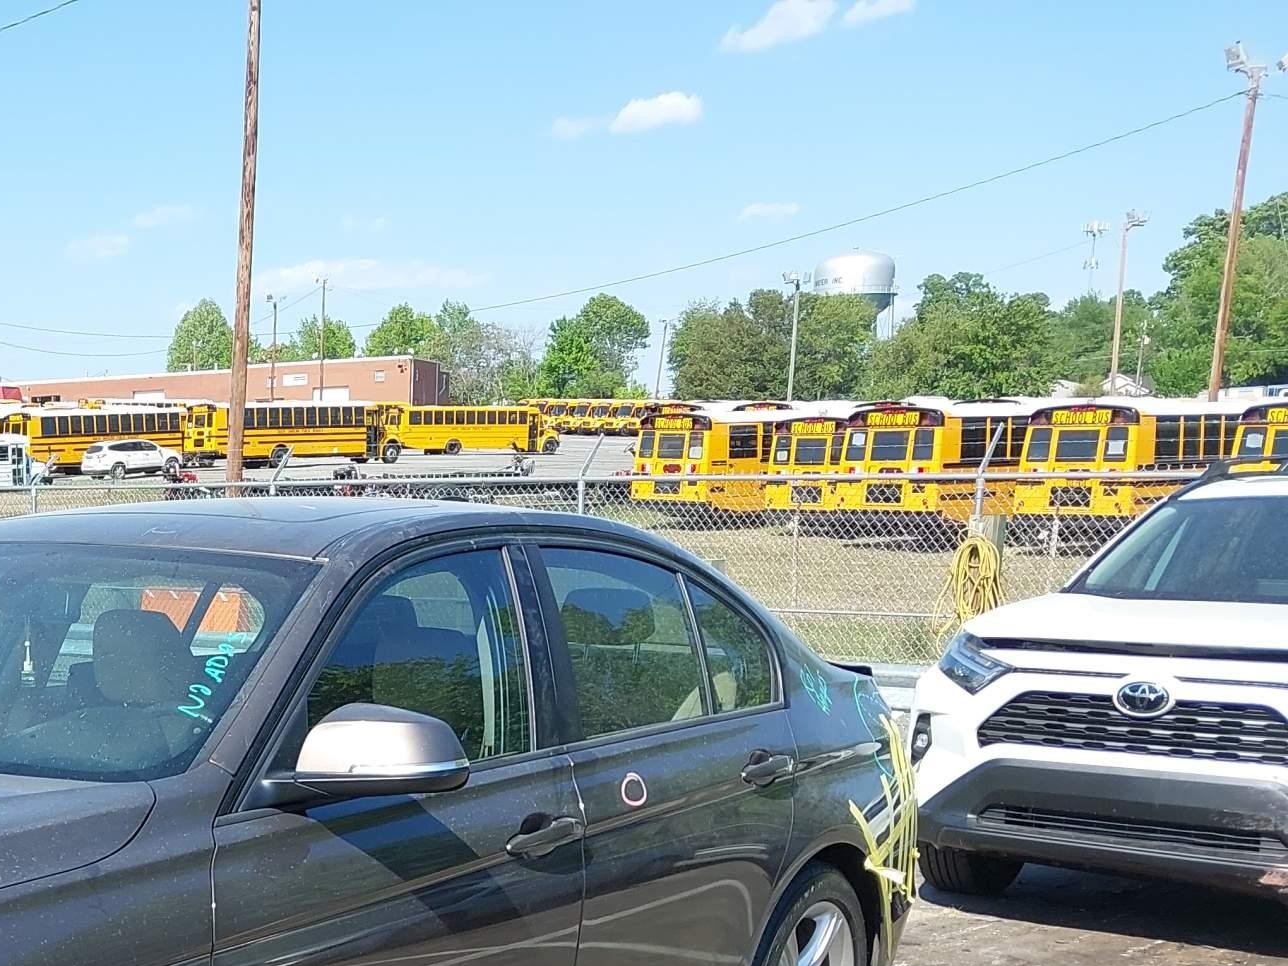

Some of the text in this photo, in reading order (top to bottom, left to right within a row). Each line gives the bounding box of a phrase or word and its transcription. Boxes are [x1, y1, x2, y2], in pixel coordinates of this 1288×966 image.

[868, 413, 918, 426] SCHOOL BUS
[1053, 410, 1111, 424] SCHOOL BUS
[792, 422, 834, 433] SCHOOL BUS
